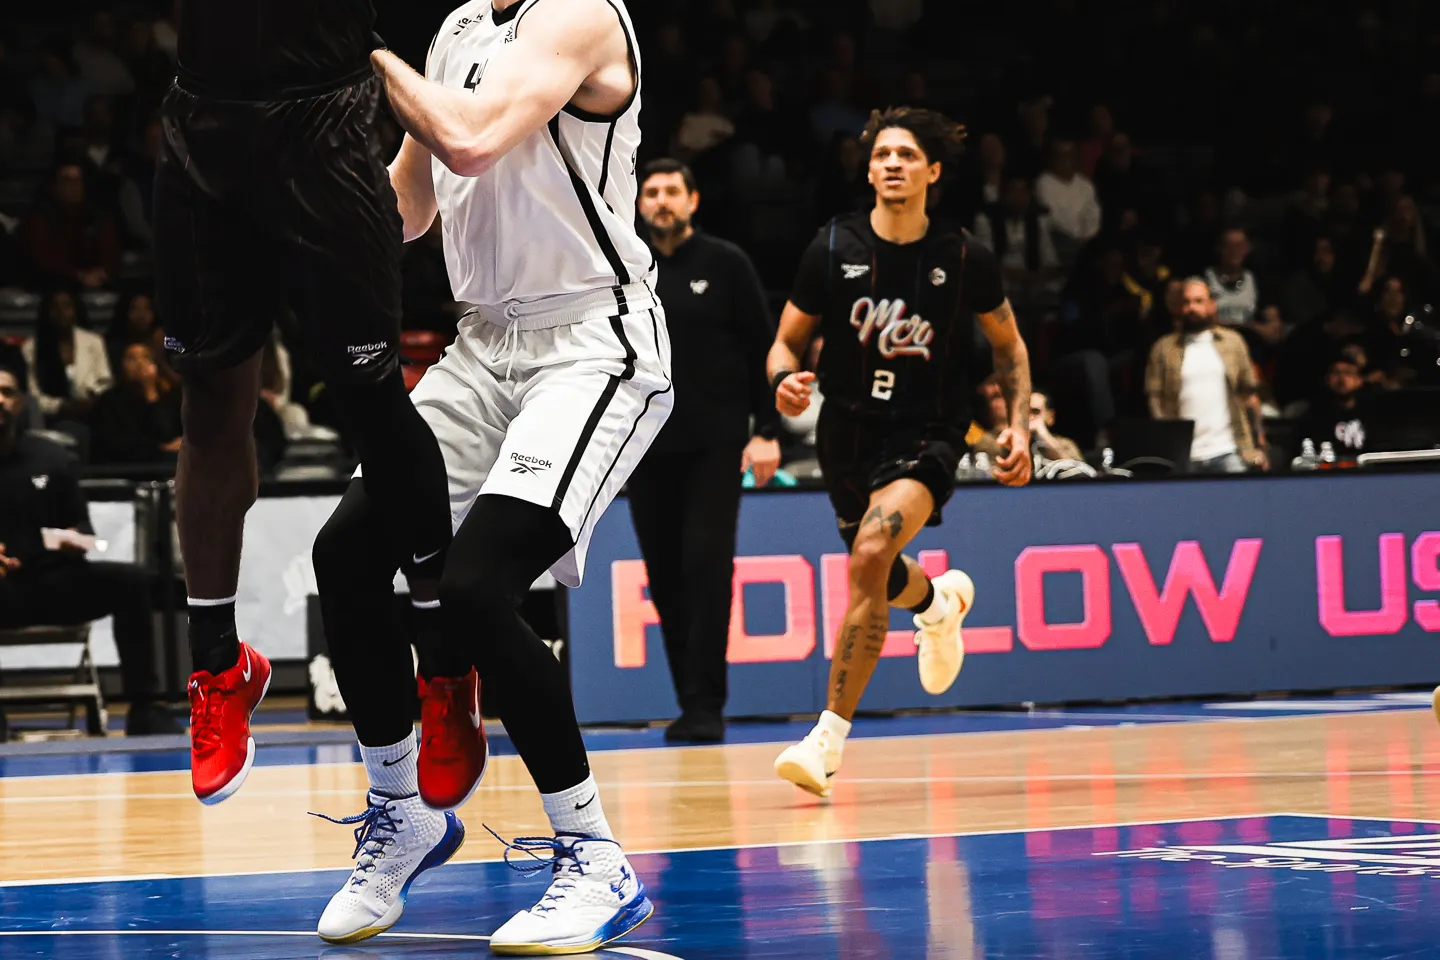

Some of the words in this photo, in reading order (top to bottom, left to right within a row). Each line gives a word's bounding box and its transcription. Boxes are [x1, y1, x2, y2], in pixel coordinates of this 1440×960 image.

[849, 296, 935, 361] Mcr
[346, 341, 388, 354] Reebok
[871, 368, 896, 401] 2
[510, 452, 553, 469] Reebok
